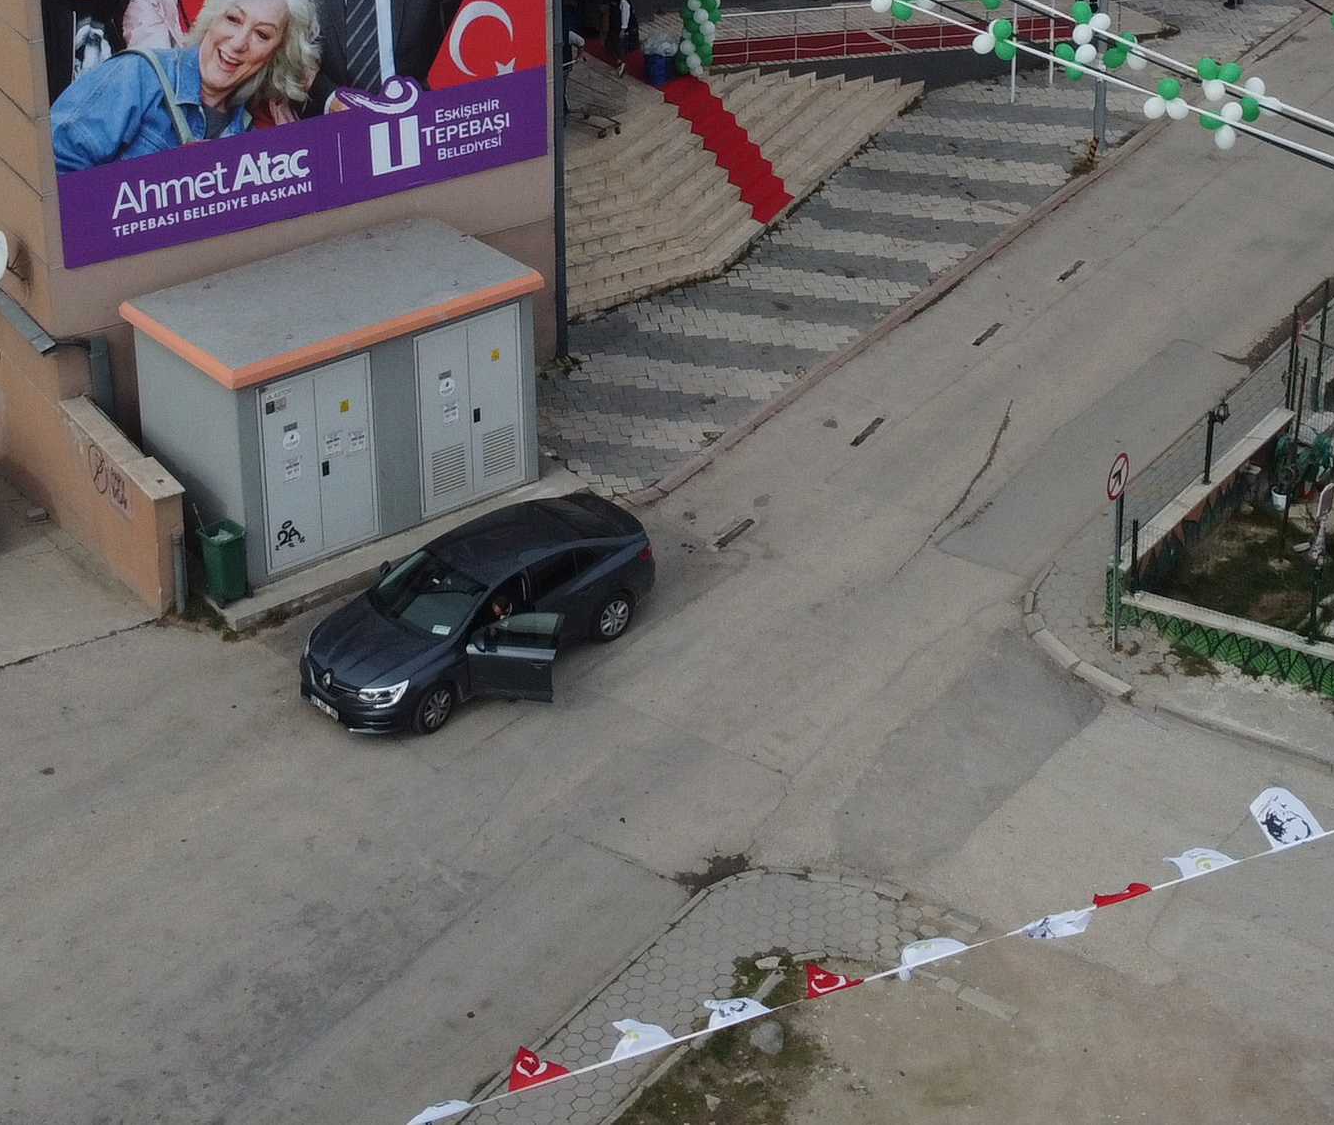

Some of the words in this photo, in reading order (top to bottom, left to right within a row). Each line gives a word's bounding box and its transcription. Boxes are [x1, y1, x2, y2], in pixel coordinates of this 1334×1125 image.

[435, 98, 500, 124] ESKİŞEHİR
[421, 112, 510, 147] TEPEBAŞI
[437, 134, 502, 161] BELEDİYESİ
[111, 162, 231, 220] Ahmet
[112, 209, 180, 238] TEPEBAŞI
[183, 195, 248, 221] BELEDİYE
[251, 181, 313, 206] BAŞKANI
